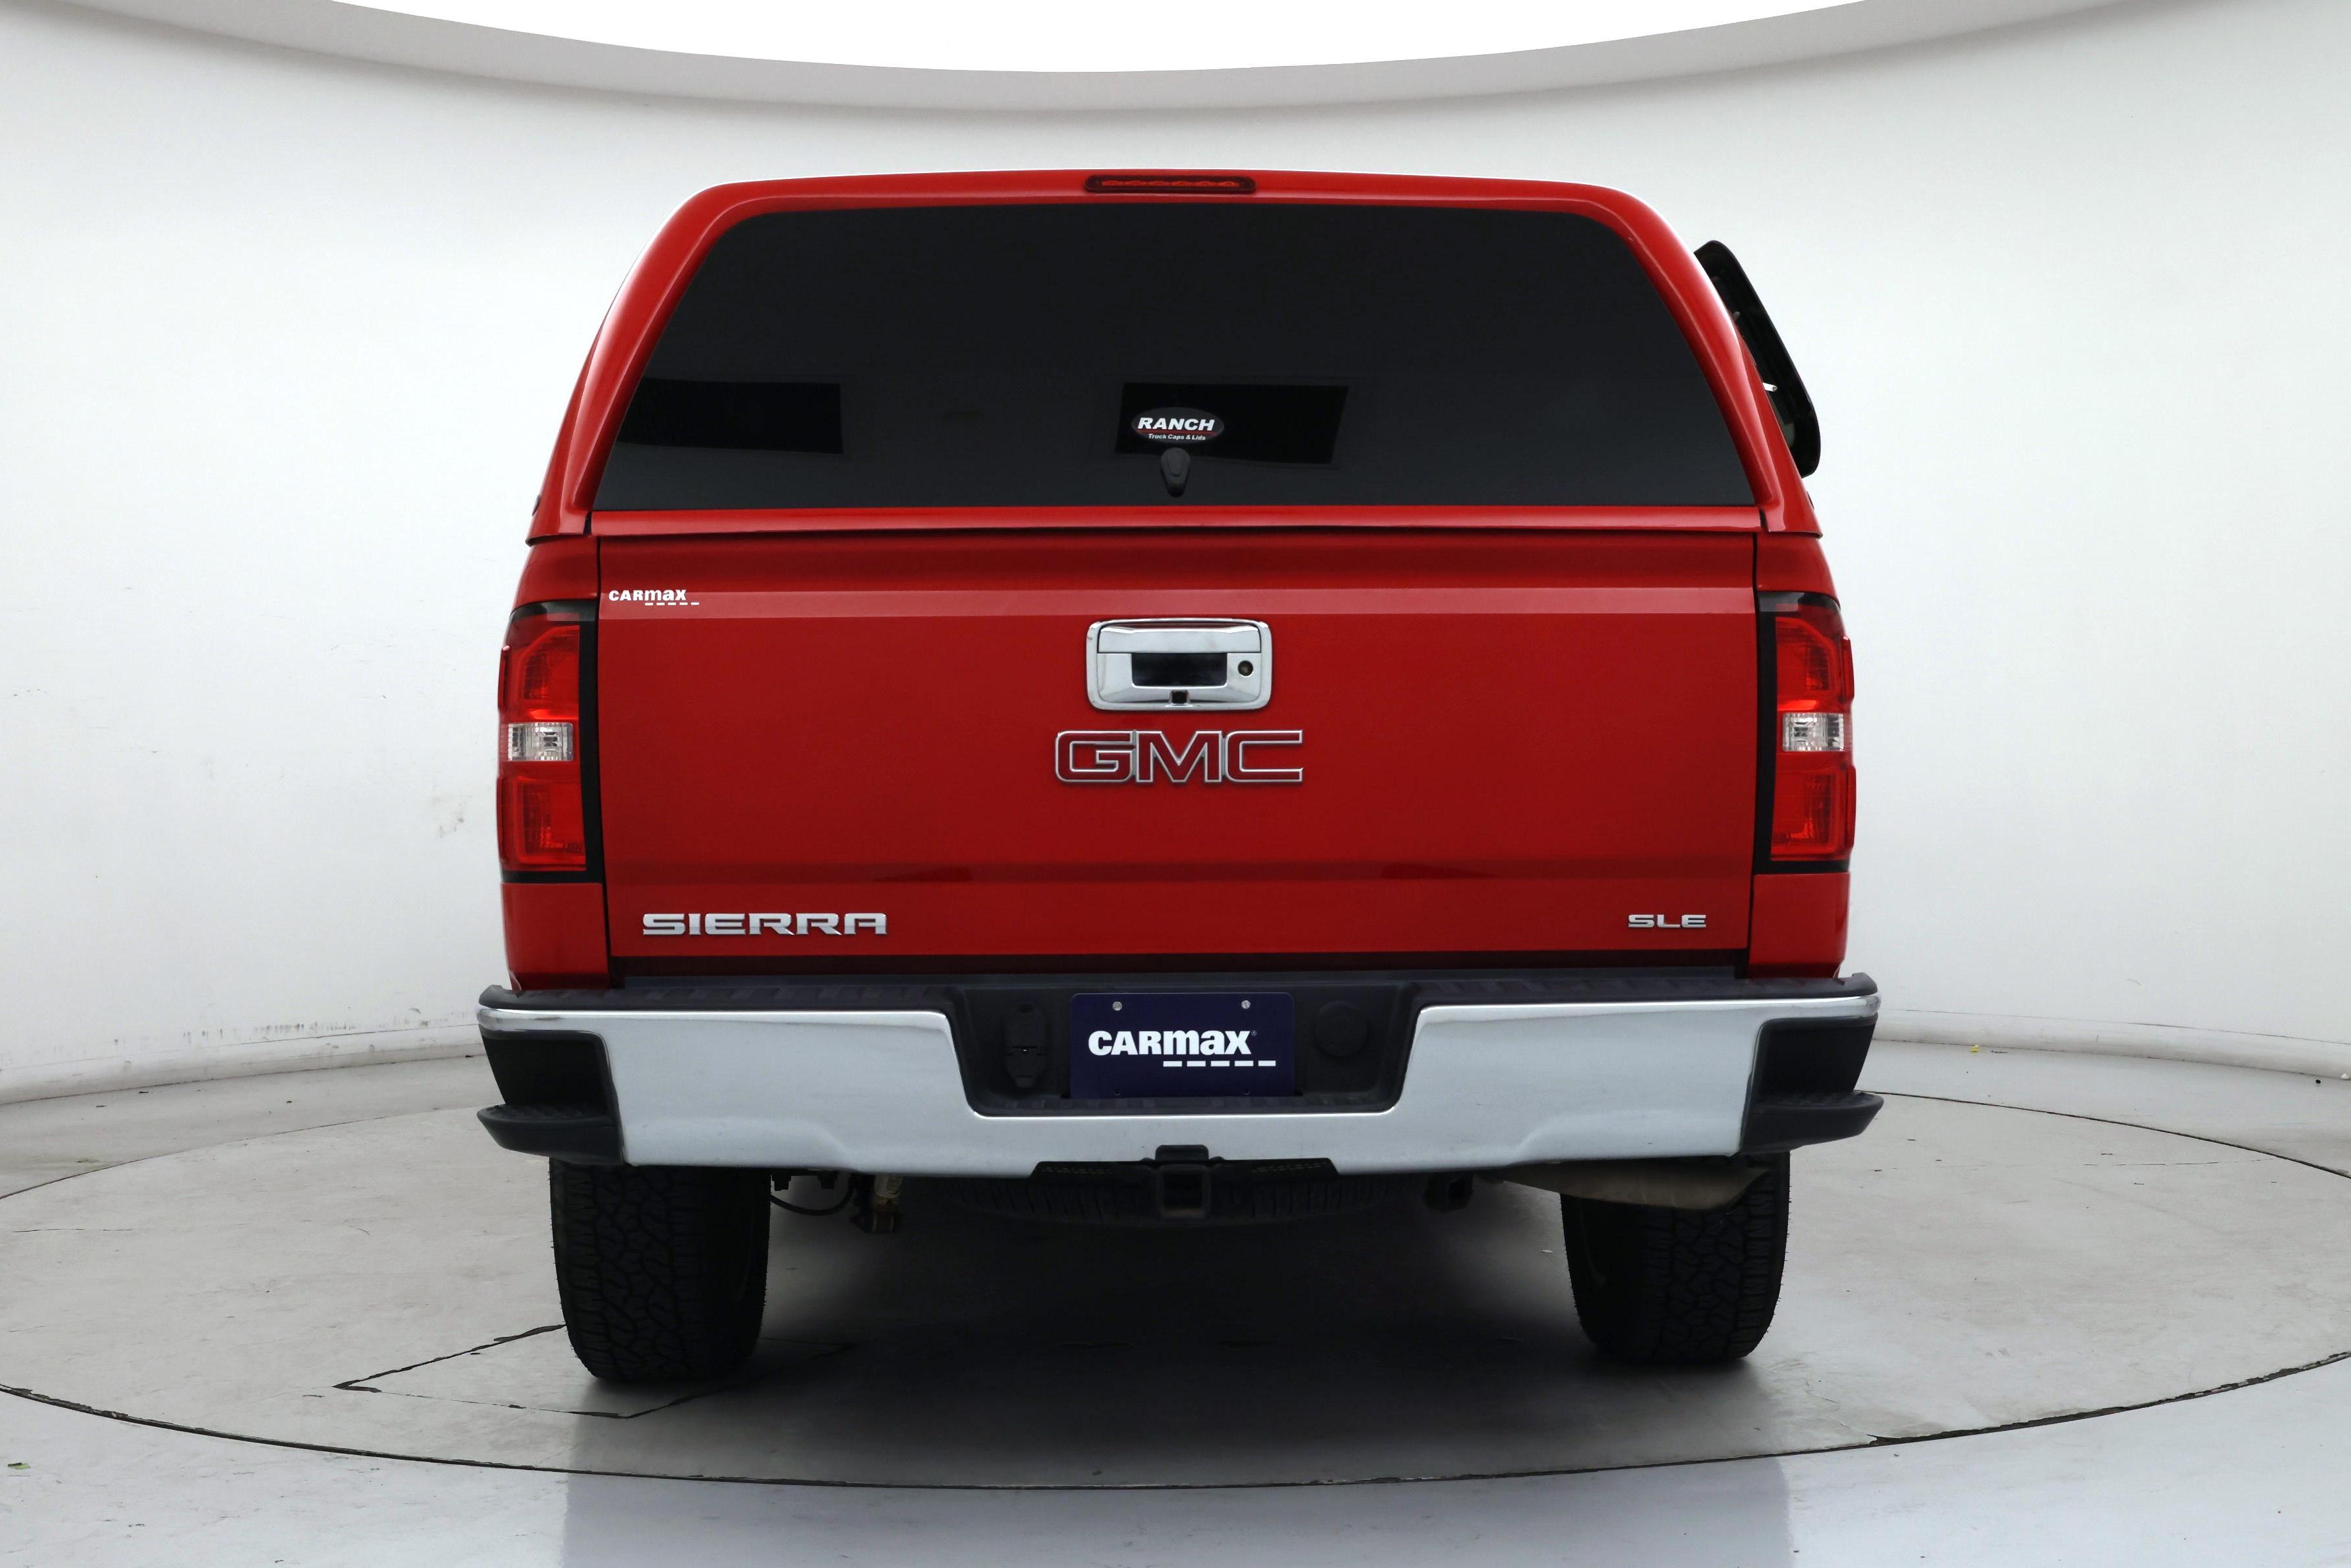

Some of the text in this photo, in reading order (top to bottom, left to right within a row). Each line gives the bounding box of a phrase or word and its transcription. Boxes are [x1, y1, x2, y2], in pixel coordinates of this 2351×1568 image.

[1138, 417, 1215, 431] RANCH
[1055, 729, 1303, 783] GMC
[643, 913, 888, 935] SIERRA
[1628, 914, 1706, 928] SLE
